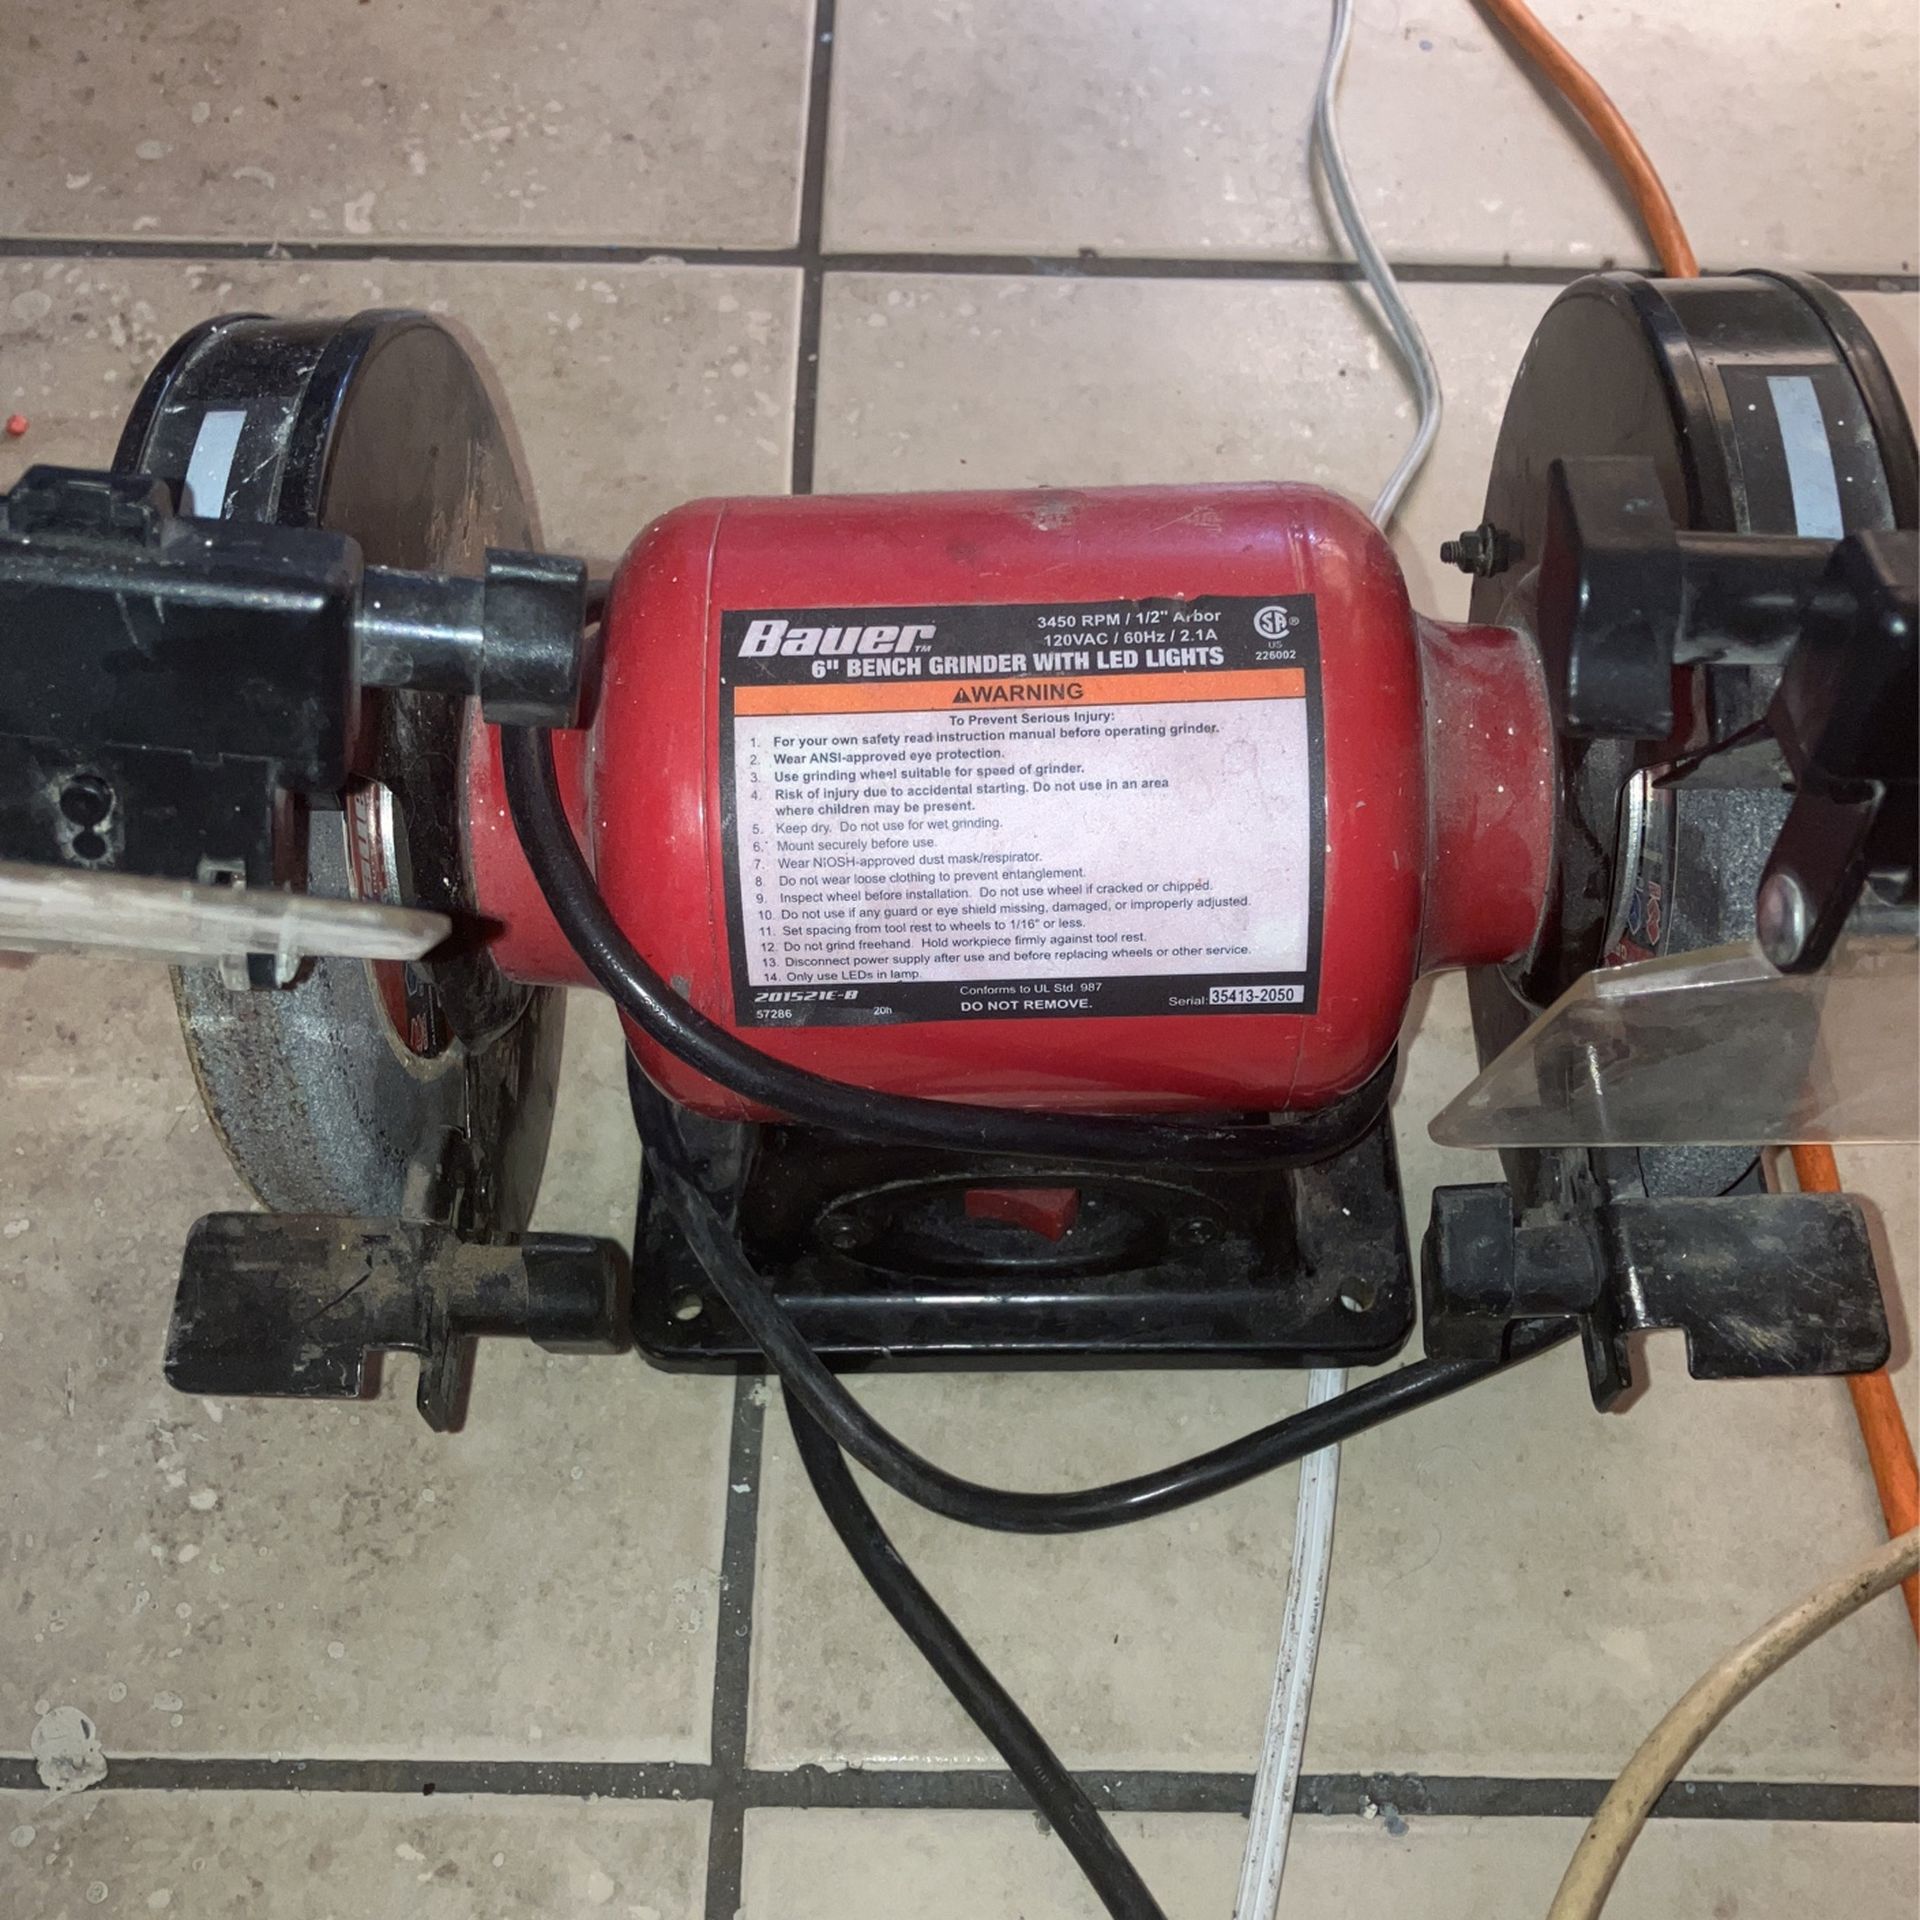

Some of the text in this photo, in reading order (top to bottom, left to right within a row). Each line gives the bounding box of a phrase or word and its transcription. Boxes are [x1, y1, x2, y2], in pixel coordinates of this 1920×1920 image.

[1038, 609, 1222, 628] 3450 RPM Arbor
[1045, 629, 1218, 646] 120VAC 60Hz 2.1A
[847, 647, 1224, 677] BENCH GRINDER WITH LED LIGHTS
[1256, 650, 1296, 660] 226002
[972, 683, 1084, 702] WARNING
[950, 711, 1114, 726] To Prevent Serious Injury:
[774, 723, 1219, 749] For your own safety read instruction manual before operating grinder.
[774, 748, 1004, 765] Wear ANSI-approved eye protection.
[774, 763, 1084, 784] Use grinding wheel suitable for speed of grinder.
[776, 779, 1168, 801] Risk of injury due to accidental starting. Do not use in an area
[776, 800, 974, 816] where children may be present.
[776, 819, 948, 835] Keep Do not use for wet
[777, 838, 937, 852] Mount securely before use.
[778, 855, 944, 869] Wear dust
[779, 868, 1086, 886] Do not wear loose clothing to prevent entanglement.
[780, 878, 1212, 905] Inspect wheel before Do not use wheel if cracked or chipped.
[782, 896, 1251, 919] Do not use if any guard or eye shield damaged, or improperly adjusted.
[782, 918, 1086, 937] Set spacing from tool rest to wheels to or less.
[784, 933, 1147, 953] Do not grind Hold workpiece firmly against tool rest.
[785, 946, 1252, 967] Disconnect power supply after use and before replacing wheels or other service.
[786, 972, 814, 983] Only
[842, 970, 874, 980] LEDs
[877, 970, 887, 979] in
[960, 983, 1102, 995] Conforms to UL 987
[1211, 987, 1295, 1003] 35413-2050
[756, 1007, 892, 1018] 57286 20h
[961, 999, 1092, 1011] DO NOT REMOVE.
